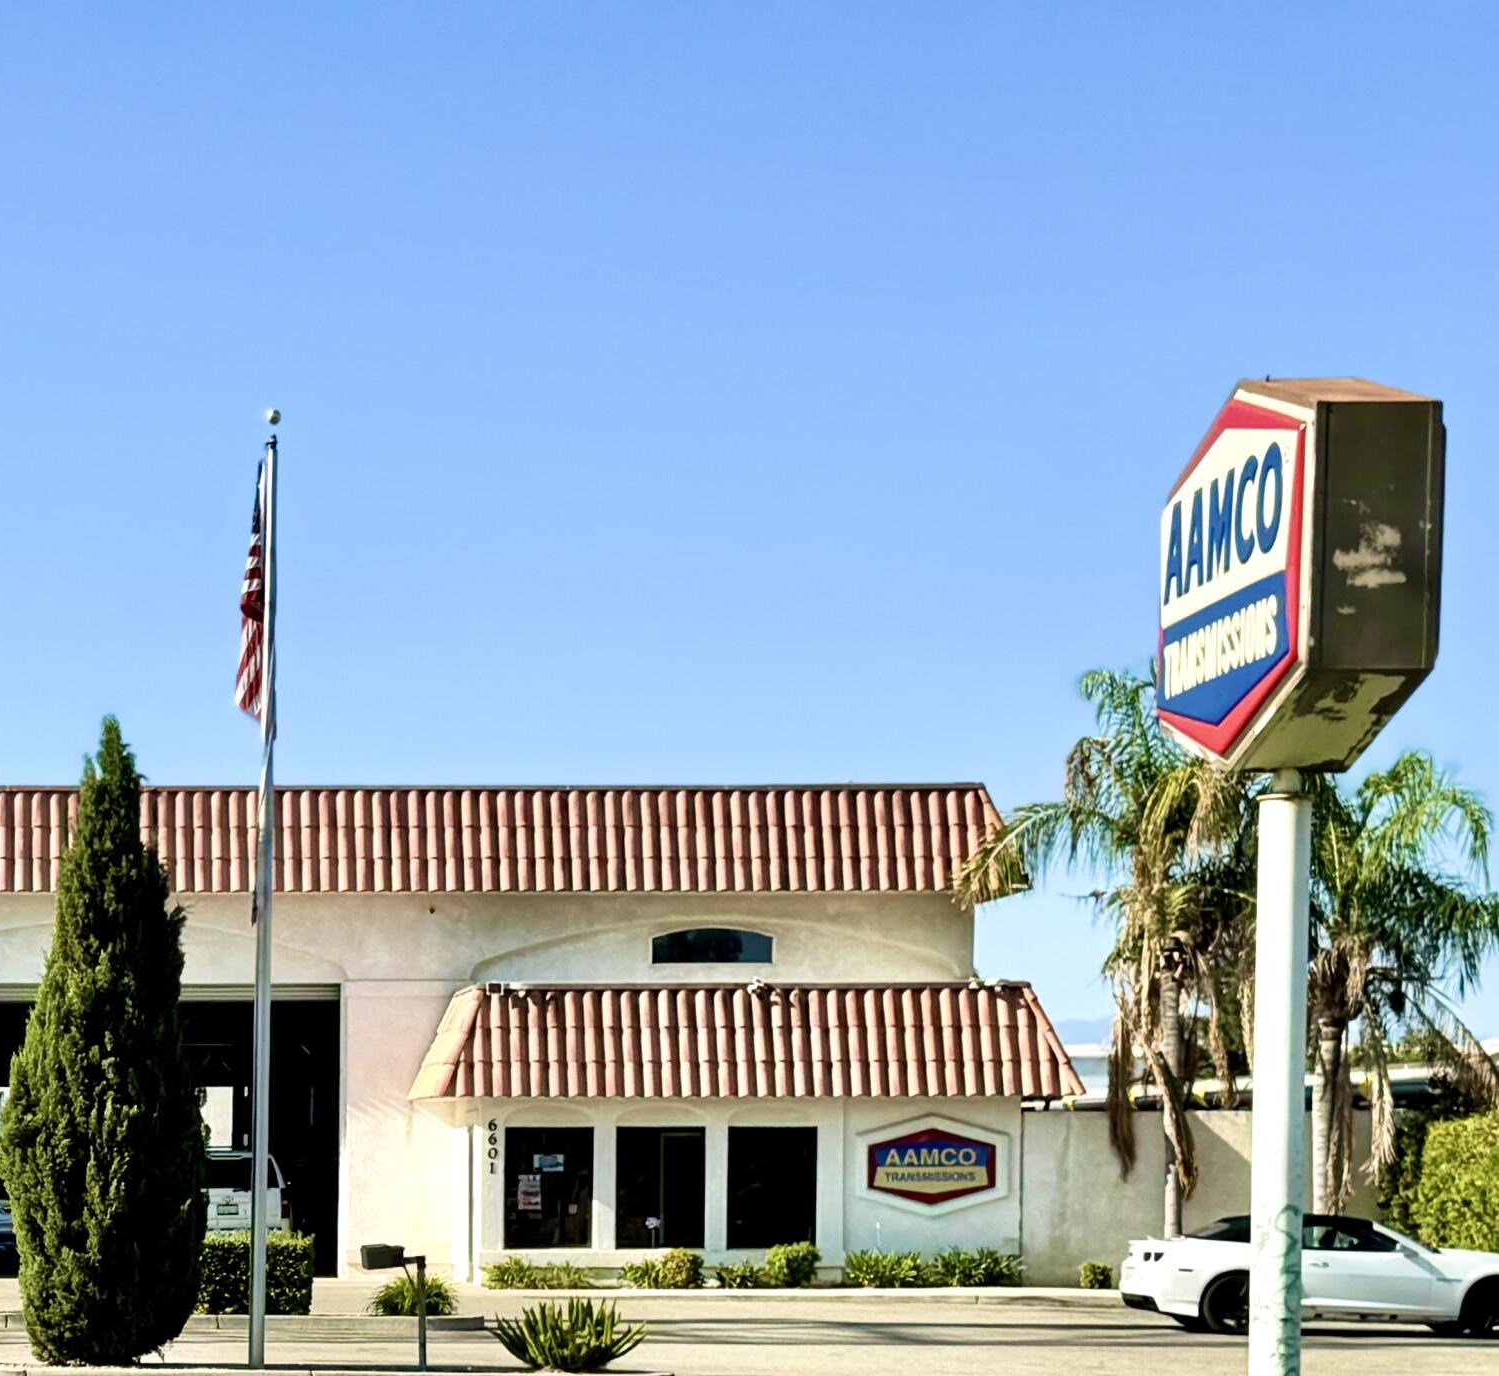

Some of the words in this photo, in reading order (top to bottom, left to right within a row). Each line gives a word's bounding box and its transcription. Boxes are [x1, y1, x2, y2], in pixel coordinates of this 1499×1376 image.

[1163, 441, 1284, 607] AAMCO
[1163, 594, 1278, 700] TRANSMISSIONS
[488, 1118, 498, 1174] 6601
[885, 1148, 977, 1166] AAMCO
[885, 1171, 976, 1182] TRANSMISSIONS
